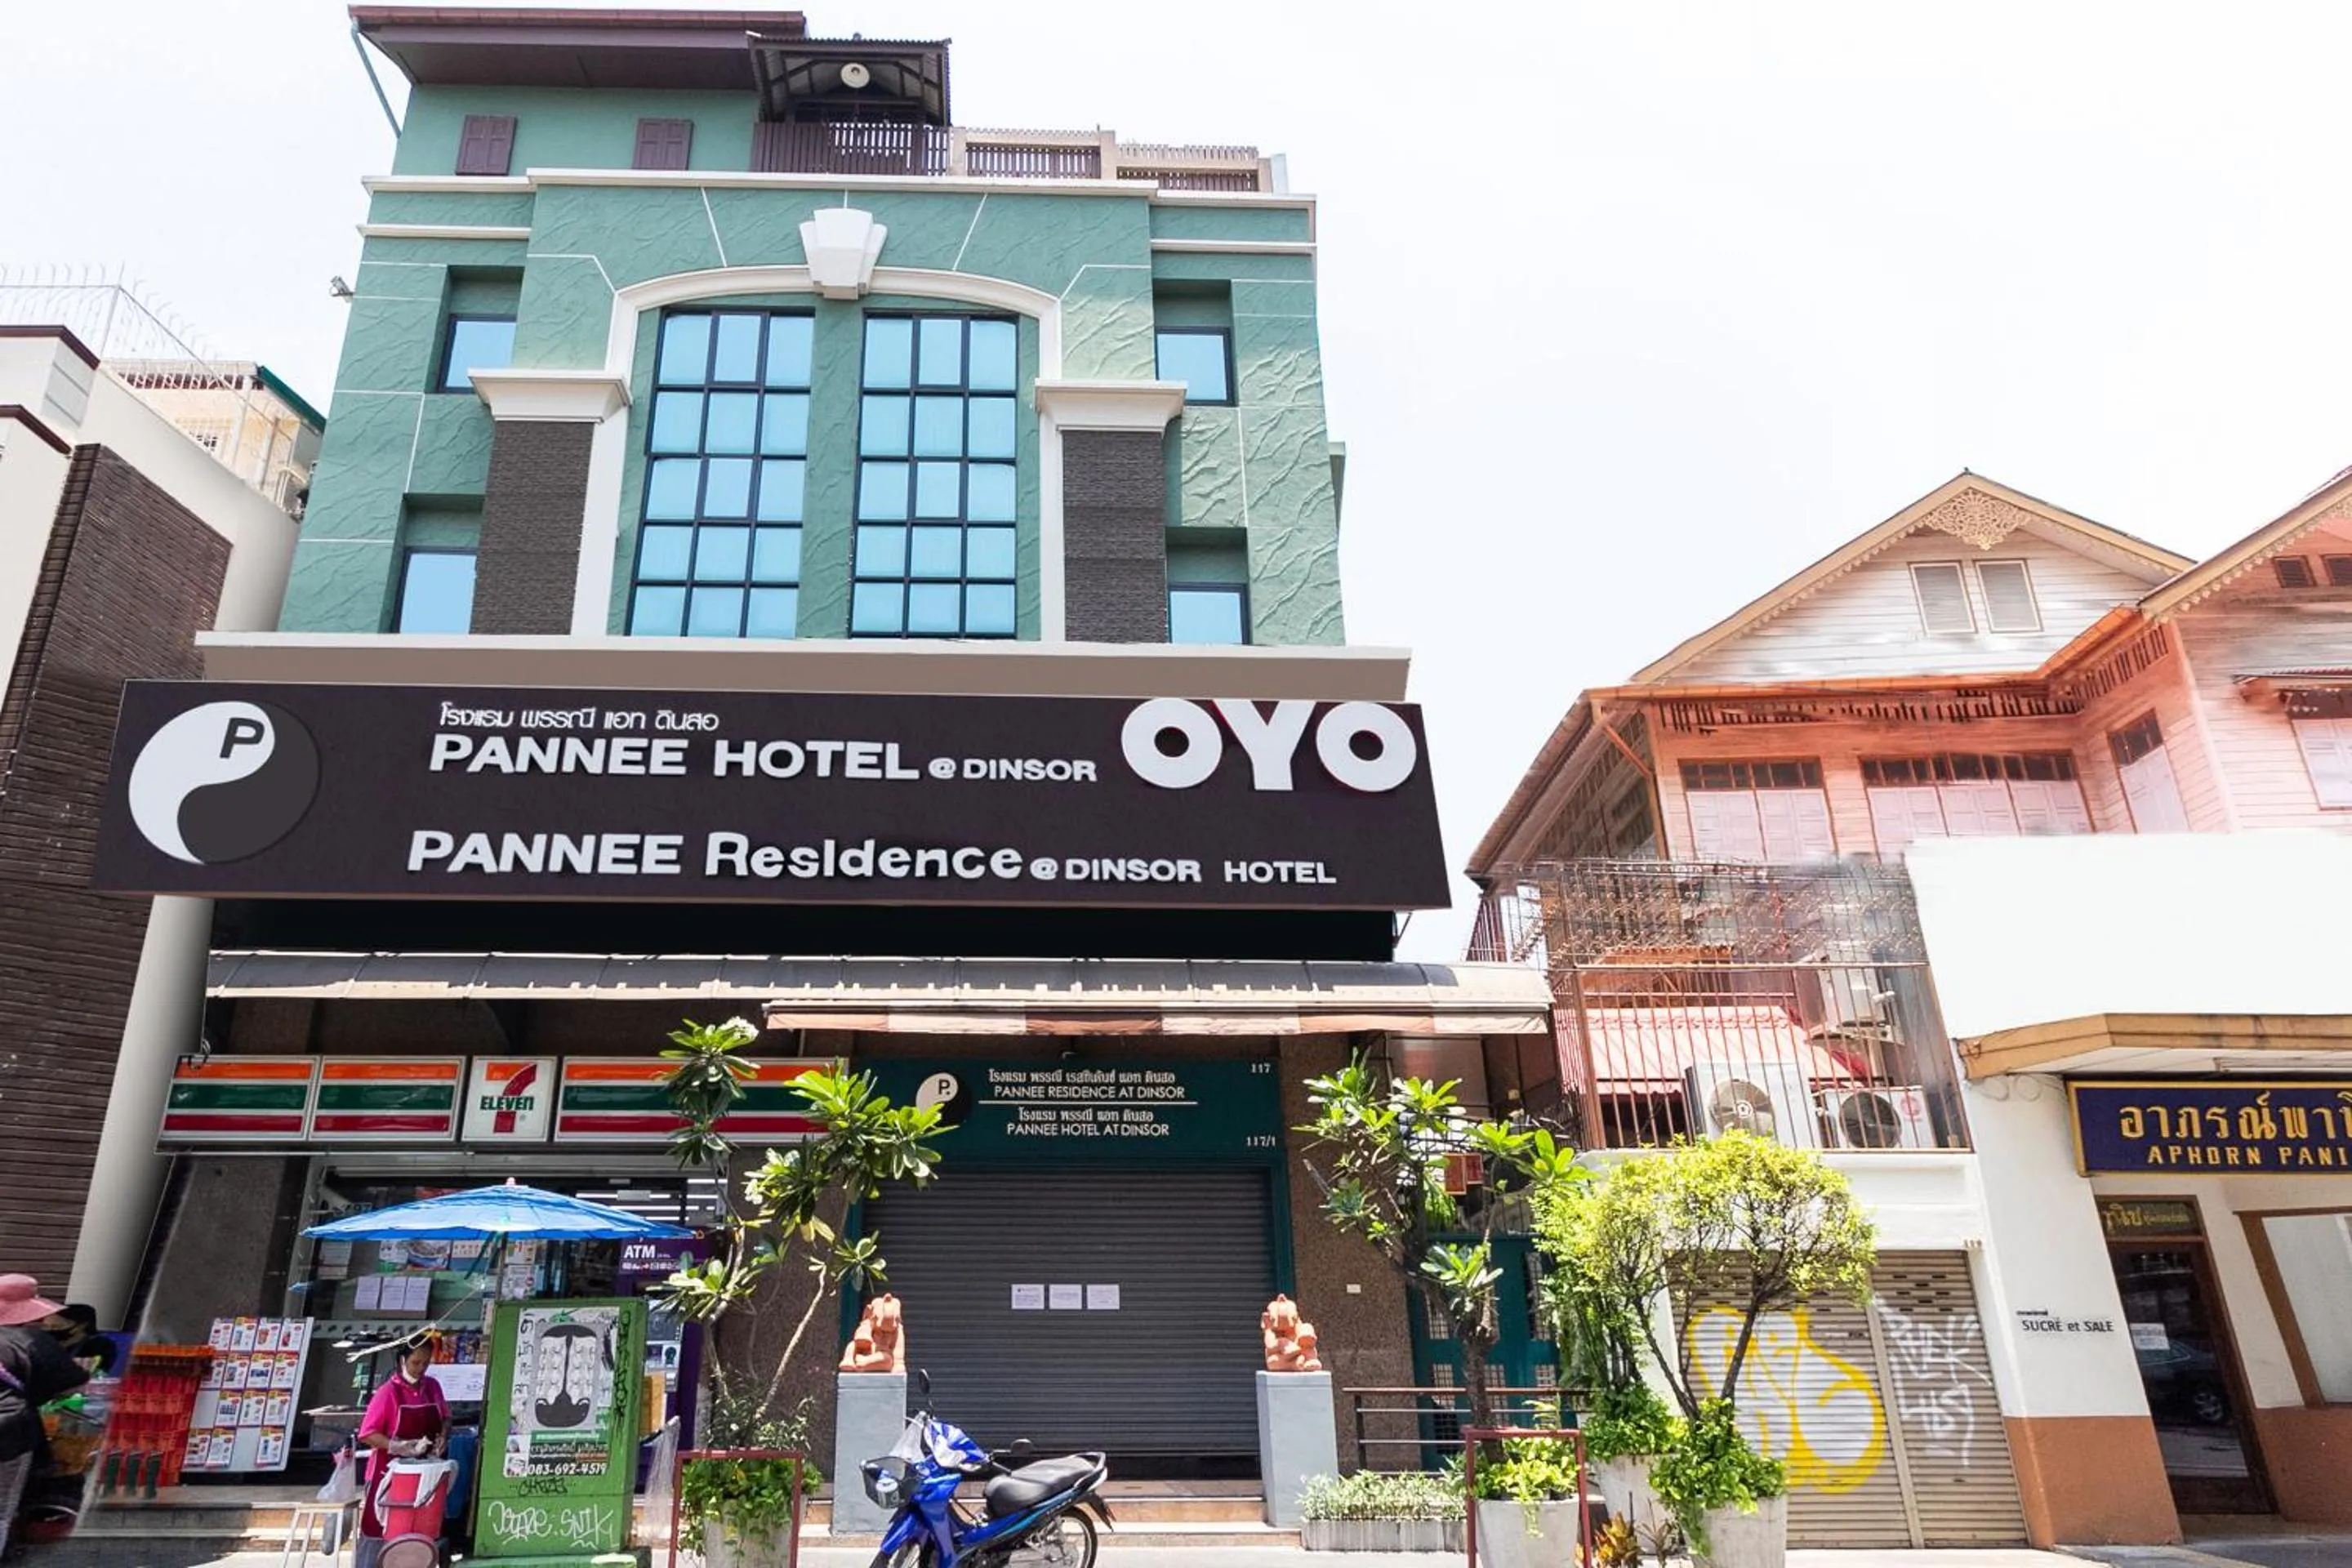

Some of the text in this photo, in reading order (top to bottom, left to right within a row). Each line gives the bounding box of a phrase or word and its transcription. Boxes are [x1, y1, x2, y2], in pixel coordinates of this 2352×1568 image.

[440, 702, 719, 732] โรงแรม พรรณี แอท ดินสอ
[220, 717, 266, 760] P
[1120, 697, 1417, 792] OYO
[430, 734, 688, 775] PANNEE
[714, 739, 920, 779] HOTEL
[408, 830, 684, 875] PANNEE
[1223, 860, 1337, 884] HOTEL
[988, 1068, 1027, 1083] โรงแรม
[1250, 1063, 1271, 1073] 117
[485, 1062, 537, 1134] 7
[994, 1086, 1186, 1098] PANNEE RESIDENCE AT DINSOR
[1018, 1107, 1057, 1122] โรงแรม
[1006, 1123, 1169, 1136] PANNEE HOTEL AT DINSOR
[2146, 1145, 2262, 1166] APHORN
[623, 1244, 656, 1258] ATM
[2067, 1321, 2082, 1333] et
